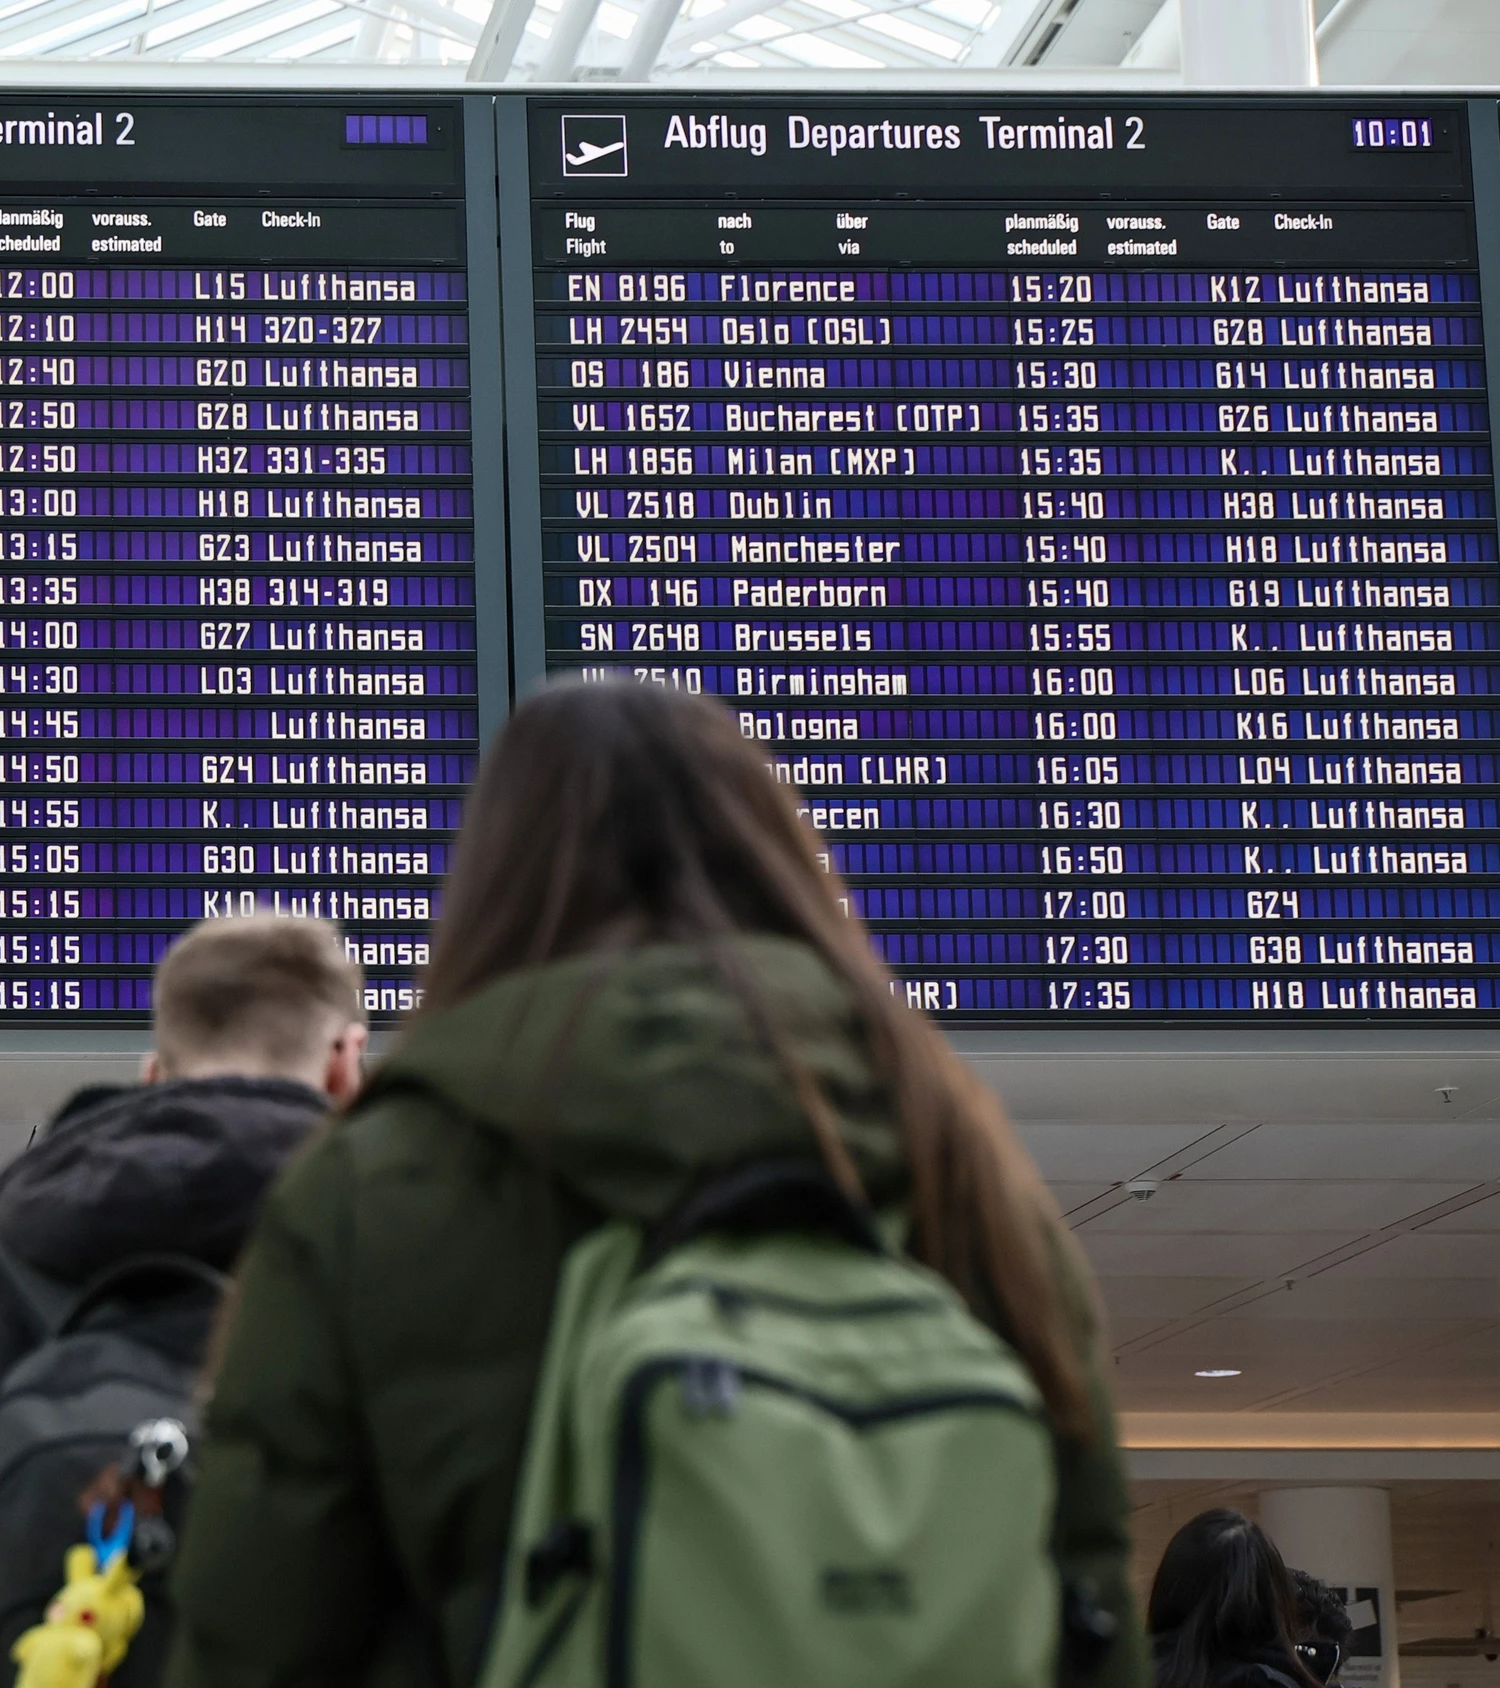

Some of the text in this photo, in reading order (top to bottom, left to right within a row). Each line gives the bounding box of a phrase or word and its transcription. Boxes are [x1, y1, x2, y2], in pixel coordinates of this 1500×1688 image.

[116, 112, 135, 145] 2
[664, 114, 1146, 157] Abflug Departures Terminal 2
[1355, 120, 1430, 147] 10:01
[92, 213, 151, 227] vorauss.
[193, 210, 227, 227] Gate
[261, 210, 321, 228] Check-In
[565, 212, 1333, 233] Flug nach über planmäßig vorauss. Gate Check-In
[91, 235, 162, 252] estimated
[566, 238, 1177, 258] Flight to via scheduled estimated
[568, 274, 1429, 303] EN 8196 Florence 15:20 K12 Lufthansa
[265, 359, 417, 388] Lufthansa
[571, 360, 604, 388] OS
[642, 360, 689, 388] 186
[724, 361, 825, 389] Vienna
[1016, 361, 1096, 389] 15:30
[1283, 362, 1434, 390] Lufthansa
[198, 446, 248, 474] H32
[267, 446, 385, 475] 331-335
[198, 490, 249, 518] H18
[268, 490, 421, 519] Lufthansa
[576, 491, 1444, 520] VL 2518 Dublin 15:40 H38 Lufthansa
[270, 622, 423, 651] Lufthansa
[271, 711, 425, 740] Lufthansa
[739, 712, 1458, 740] Bologna 16:00 K16 Lufthansa
[1044, 891, 1126, 919] 17:00
[1046, 936, 1128, 965] 17:30
[1319, 935, 1473, 964] Lufthansa
